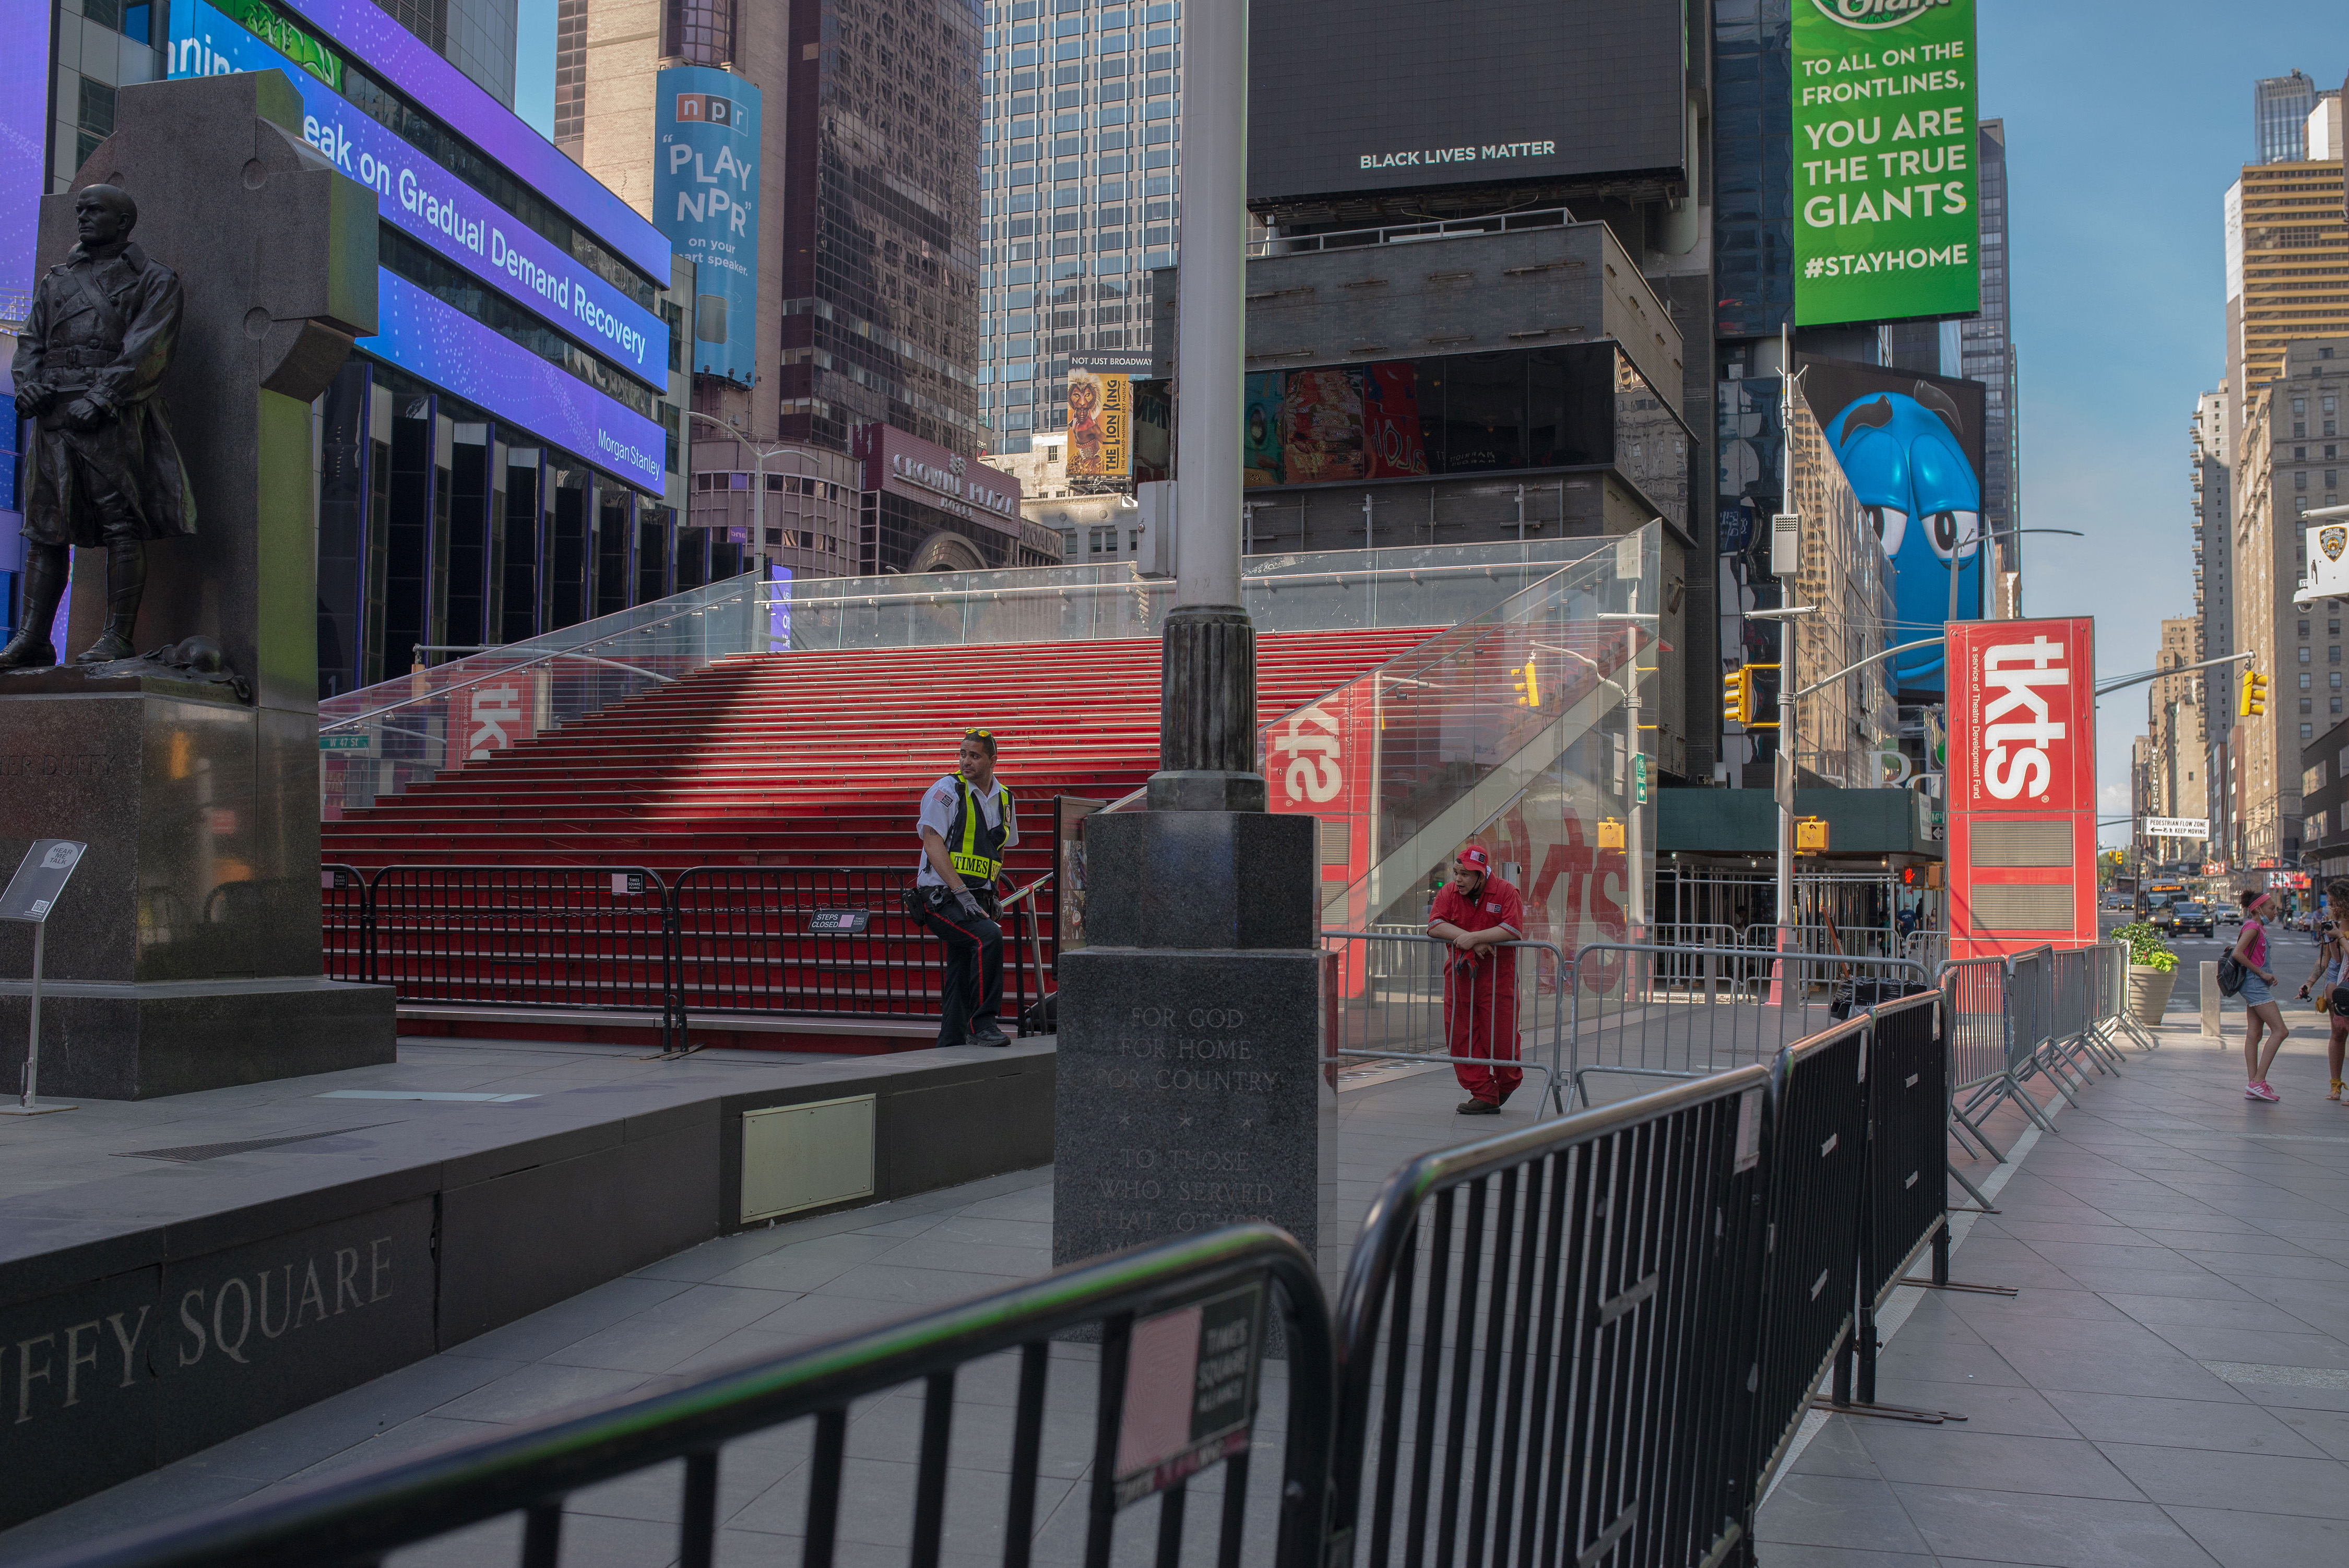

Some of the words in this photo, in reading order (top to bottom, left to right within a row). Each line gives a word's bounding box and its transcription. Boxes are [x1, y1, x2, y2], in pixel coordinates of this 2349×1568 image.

[1802, 58, 1832, 76] TO
[1837, 53, 1876, 73] ALL
[1882, 47, 1915, 66] ON
[1921, 41, 1964, 62] THE
[1802, 69, 1965, 106] FRONTLINES,
[684, 100, 743, 125] npr
[1804, 116, 1880, 150] YOU
[1892, 106, 1964, 141] ARE
[1360, 151, 1420, 169] BLACK
[1425, 147, 1476, 164] LIVES
[1481, 140, 1556, 159] MATTER
[1803, 156, 1868, 186] THE
[1877, 144, 1967, 177] TRUE
[168, 33, 244, 76] nin
[360, 153, 390, 196] on
[399, 168, 484, 256] Gradual
[492, 228, 568, 310] Demand
[575, 283, 646, 364] Recovery
[1804, 181, 1967, 228] GIANTS
[689, 237, 706, 248] on
[710, 239, 735, 254] your
[708, 255, 748, 276] speaker.
[1805, 243, 1968, 279] #STAYHOME
[1102, 379, 1121, 411] KING
[1102, 415, 1121, 445] LION
[599, 428, 630, 462] Morgan
[631, 446, 660, 481] Stanley
[1106, 448, 1117, 471] THE
[893, 454, 962, 495] CROWNE
[969, 482, 1015, 515] PLAZA
[1984, 636, 2069, 799] tkts
[330, 738, 336, 747] W
[340, 738, 348, 747] 47
[350, 738, 358, 746] St
[1971, 726, 1980, 777] Development
[0, 755, 32, 777] ER
[42, 753, 119, 777] DUFFY
[2151, 747, 2160, 810] WELLINGTON
[50, 857, 68, 865] TALK
[53, 847, 73, 856] HEAR
[954, 856, 989, 875] TIMES
[1132, 1008, 1177, 1028] FOR
[1189, 1008, 1243, 1028] GOD
[1121, 1038, 1166, 1059] FOR
[1178, 1039, 1252, 1060] HOME
[1096, 1068, 1140, 1089] FOR
[1155, 1070, 1279, 1092] COUNTRY
[1120, 1148, 1155, 1168] TO
[1169, 1150, 1250, 1172] THOSE
[1098, 1180, 1160, 1199] WHO
[1179, 1182, 1273, 1203] SERVED
[0, 1305, 151, 1425] FFY
[178, 1236, 394, 1368] SQUARE
